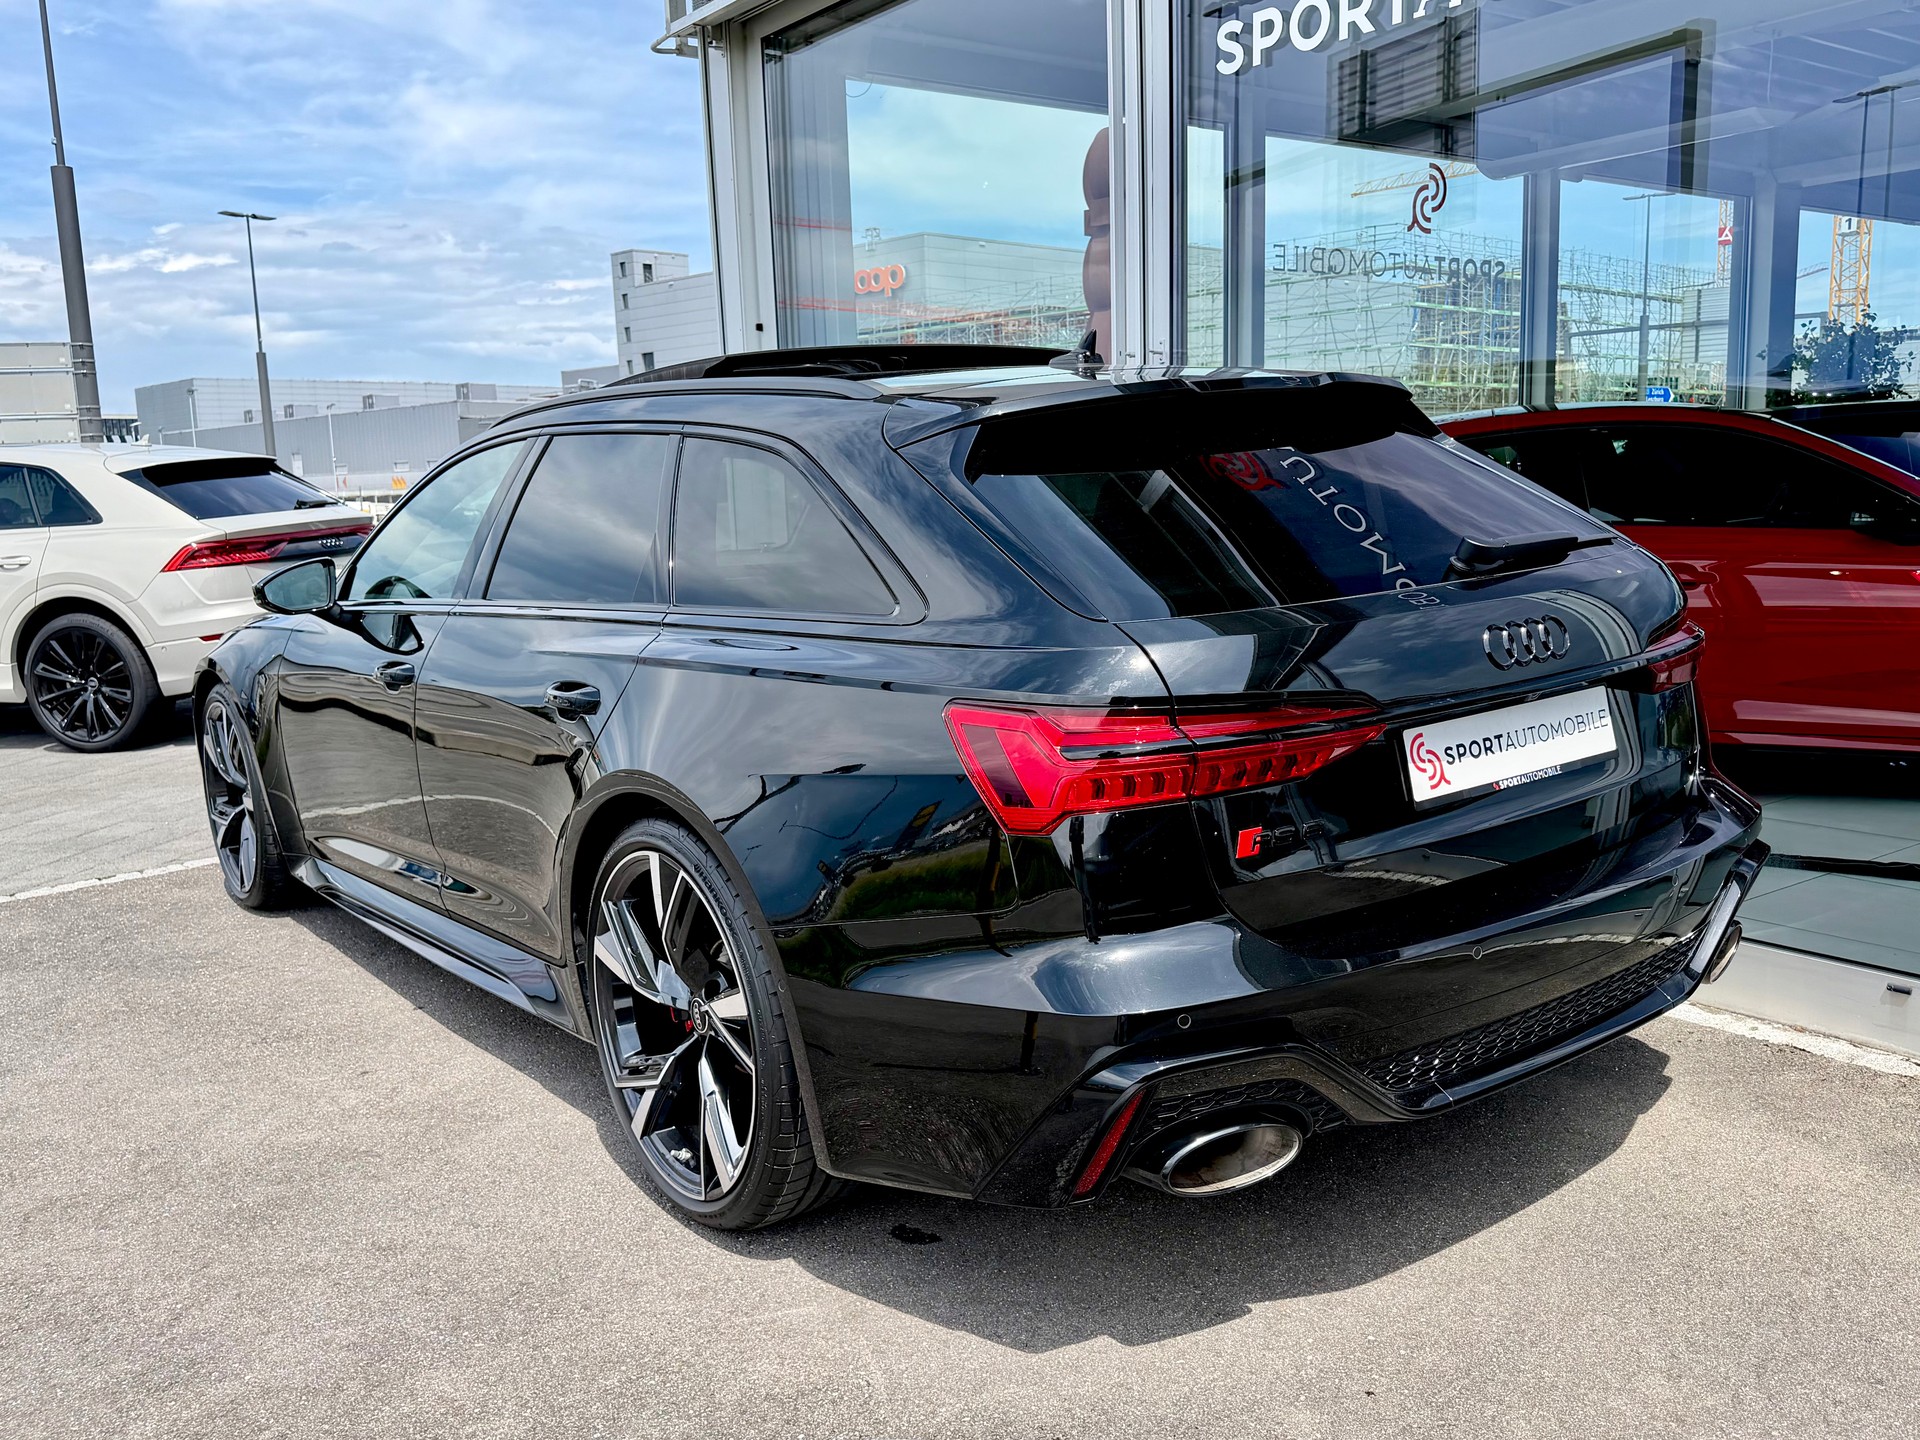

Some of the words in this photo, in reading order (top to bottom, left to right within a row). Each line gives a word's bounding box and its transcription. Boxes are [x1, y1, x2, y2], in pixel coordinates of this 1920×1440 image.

[1216, 0, 1462, 75] SPOR
[1844, 217, 1853, 230] 1
[1444, 709, 1609, 765] SPORTAUTOMOBILE
[1499, 765, 1563, 790] SPORTAUTOMOBILE
